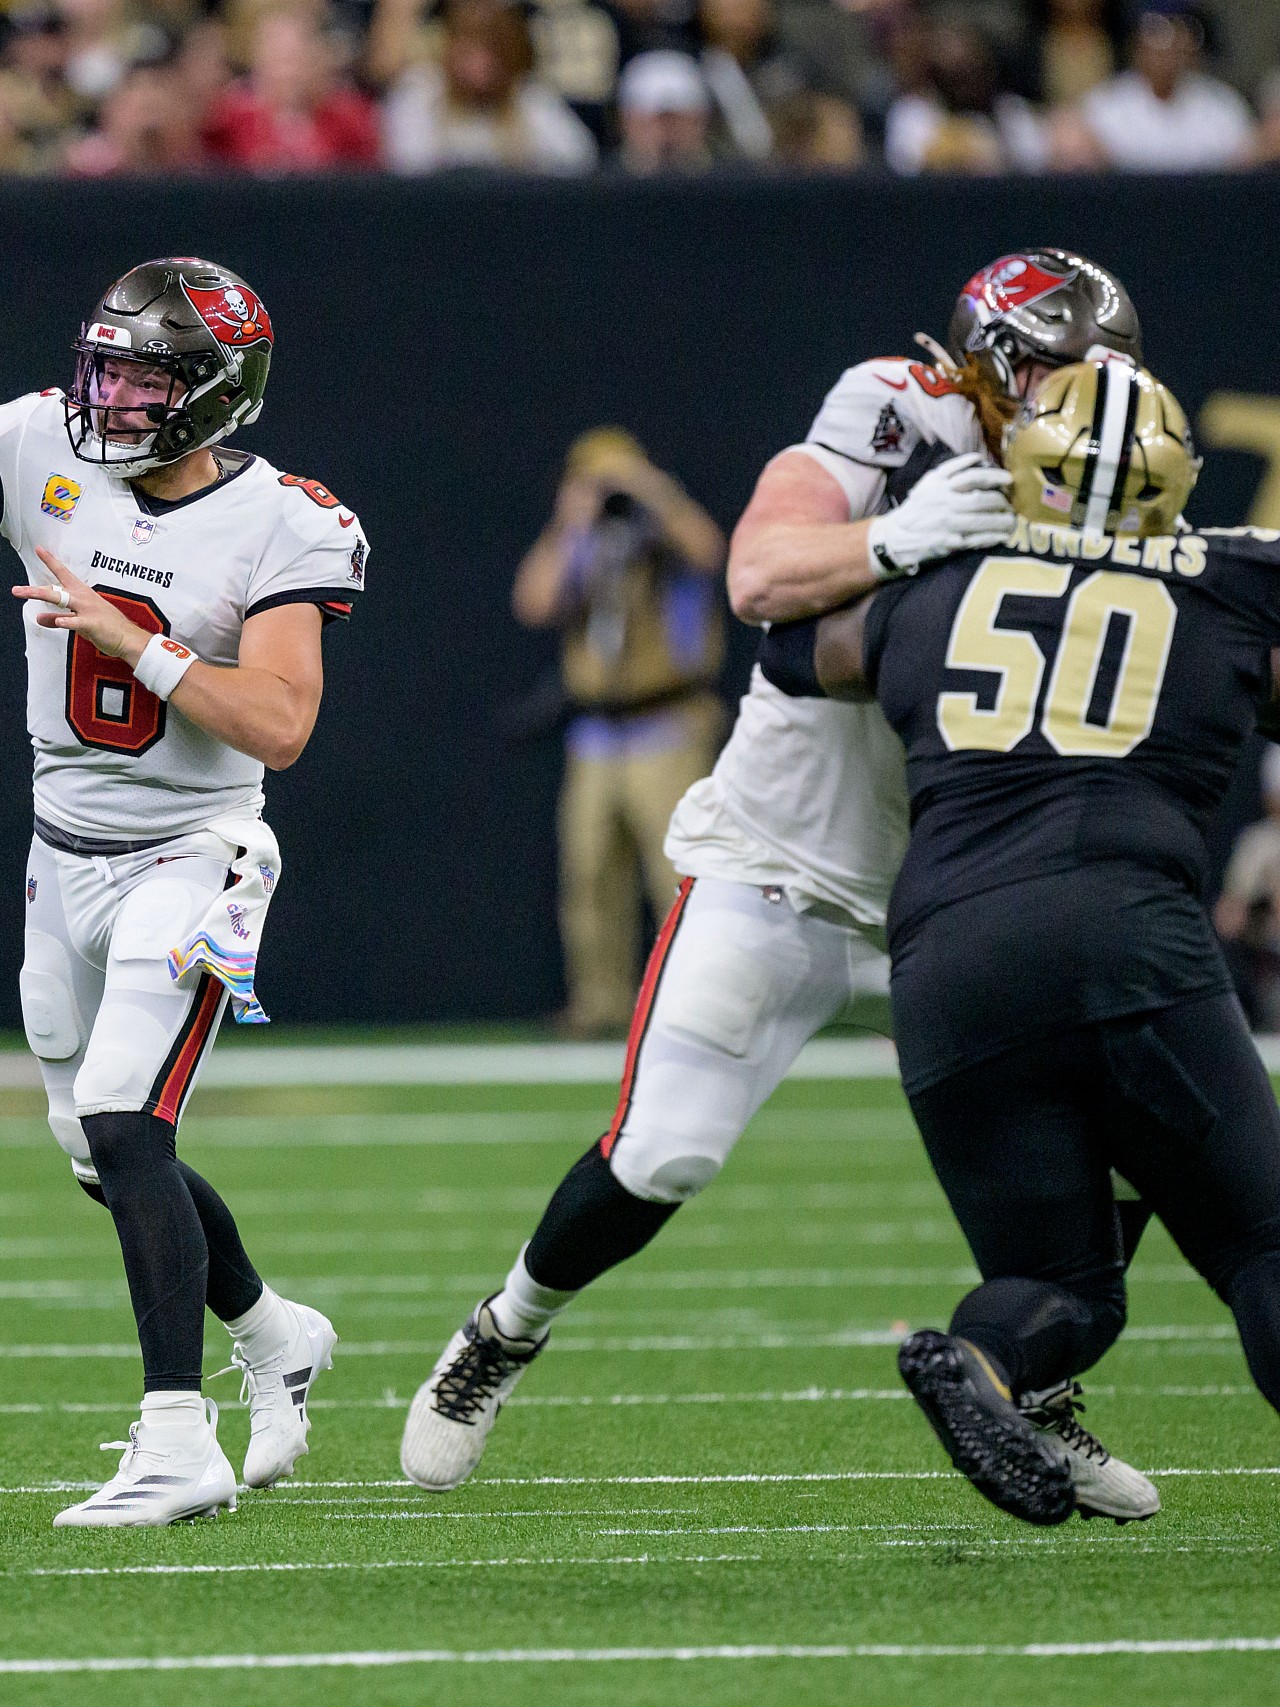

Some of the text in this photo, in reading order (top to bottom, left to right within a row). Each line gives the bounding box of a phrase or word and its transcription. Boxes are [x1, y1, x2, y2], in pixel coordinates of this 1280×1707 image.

[142, 347, 172, 355] OAKLEY
[45, 475, 81, 511] C
[91, 550, 174, 589] BUCCANEERS
[1006, 516, 1208, 577] AUNDERS
[65, 583, 171, 759] 6
[937, 556, 1178, 758] 50
